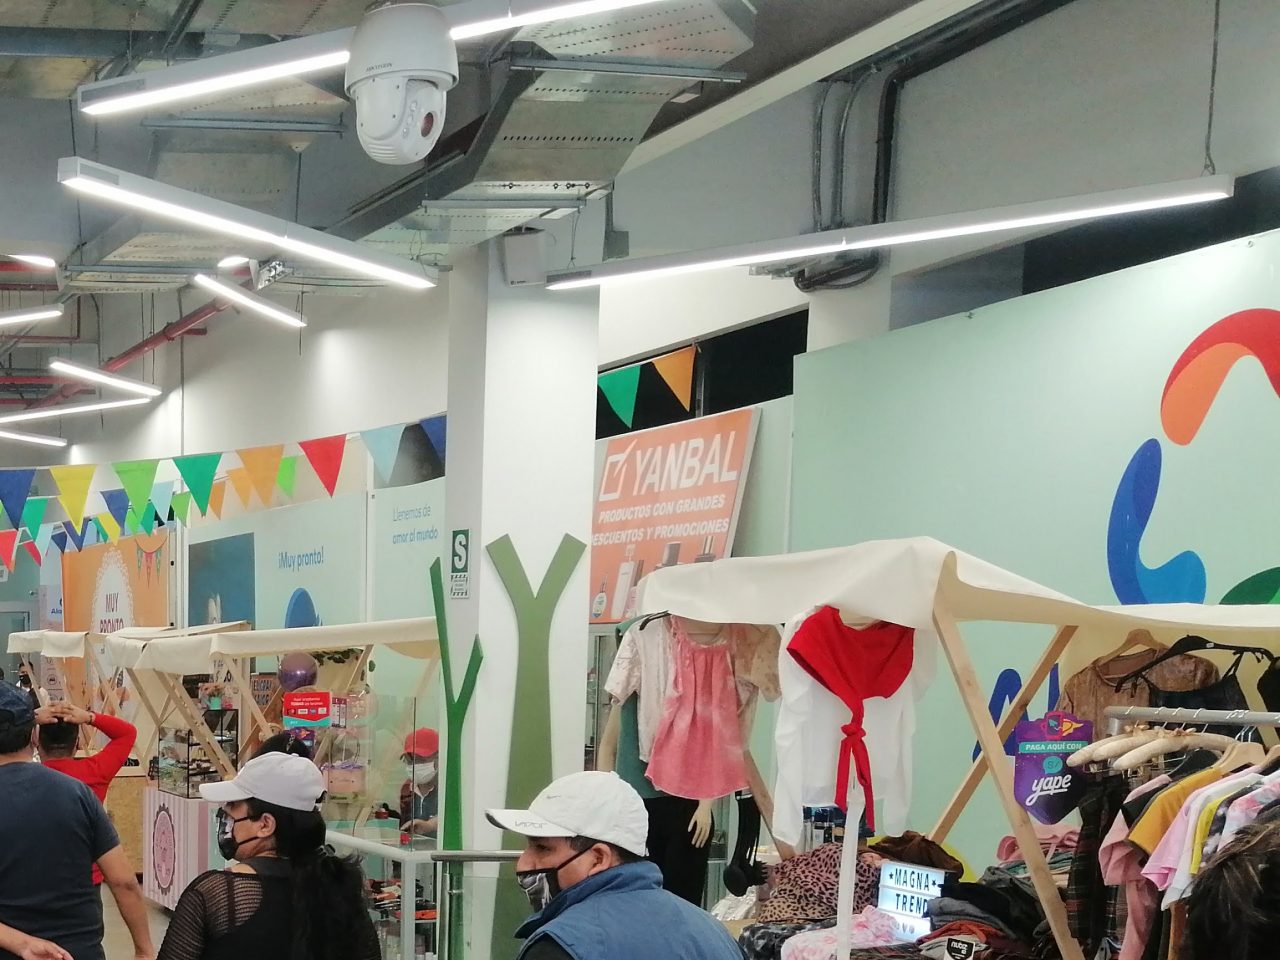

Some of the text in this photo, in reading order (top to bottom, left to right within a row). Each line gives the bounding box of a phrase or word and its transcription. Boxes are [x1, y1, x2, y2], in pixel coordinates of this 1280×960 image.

[632, 431, 737, 496] YANBAL
[393, 504, 431, 522] Llenemos de
[598, 494, 726, 523] PRODUCTOS CON GRANDES
[392, 527, 438, 544] amor al mundo
[591, 518, 729, 546] ESCUENTOS Y PROMOCIONES
[297, 546, 324, 571] pronto!
[454, 533, 467, 570] S
[105, 592, 119, 612] MUY
[1047, 742, 1065, 750] AQUÍ
[1025, 774, 1072, 806] yape
[894, 868, 930, 891] MAGNA
